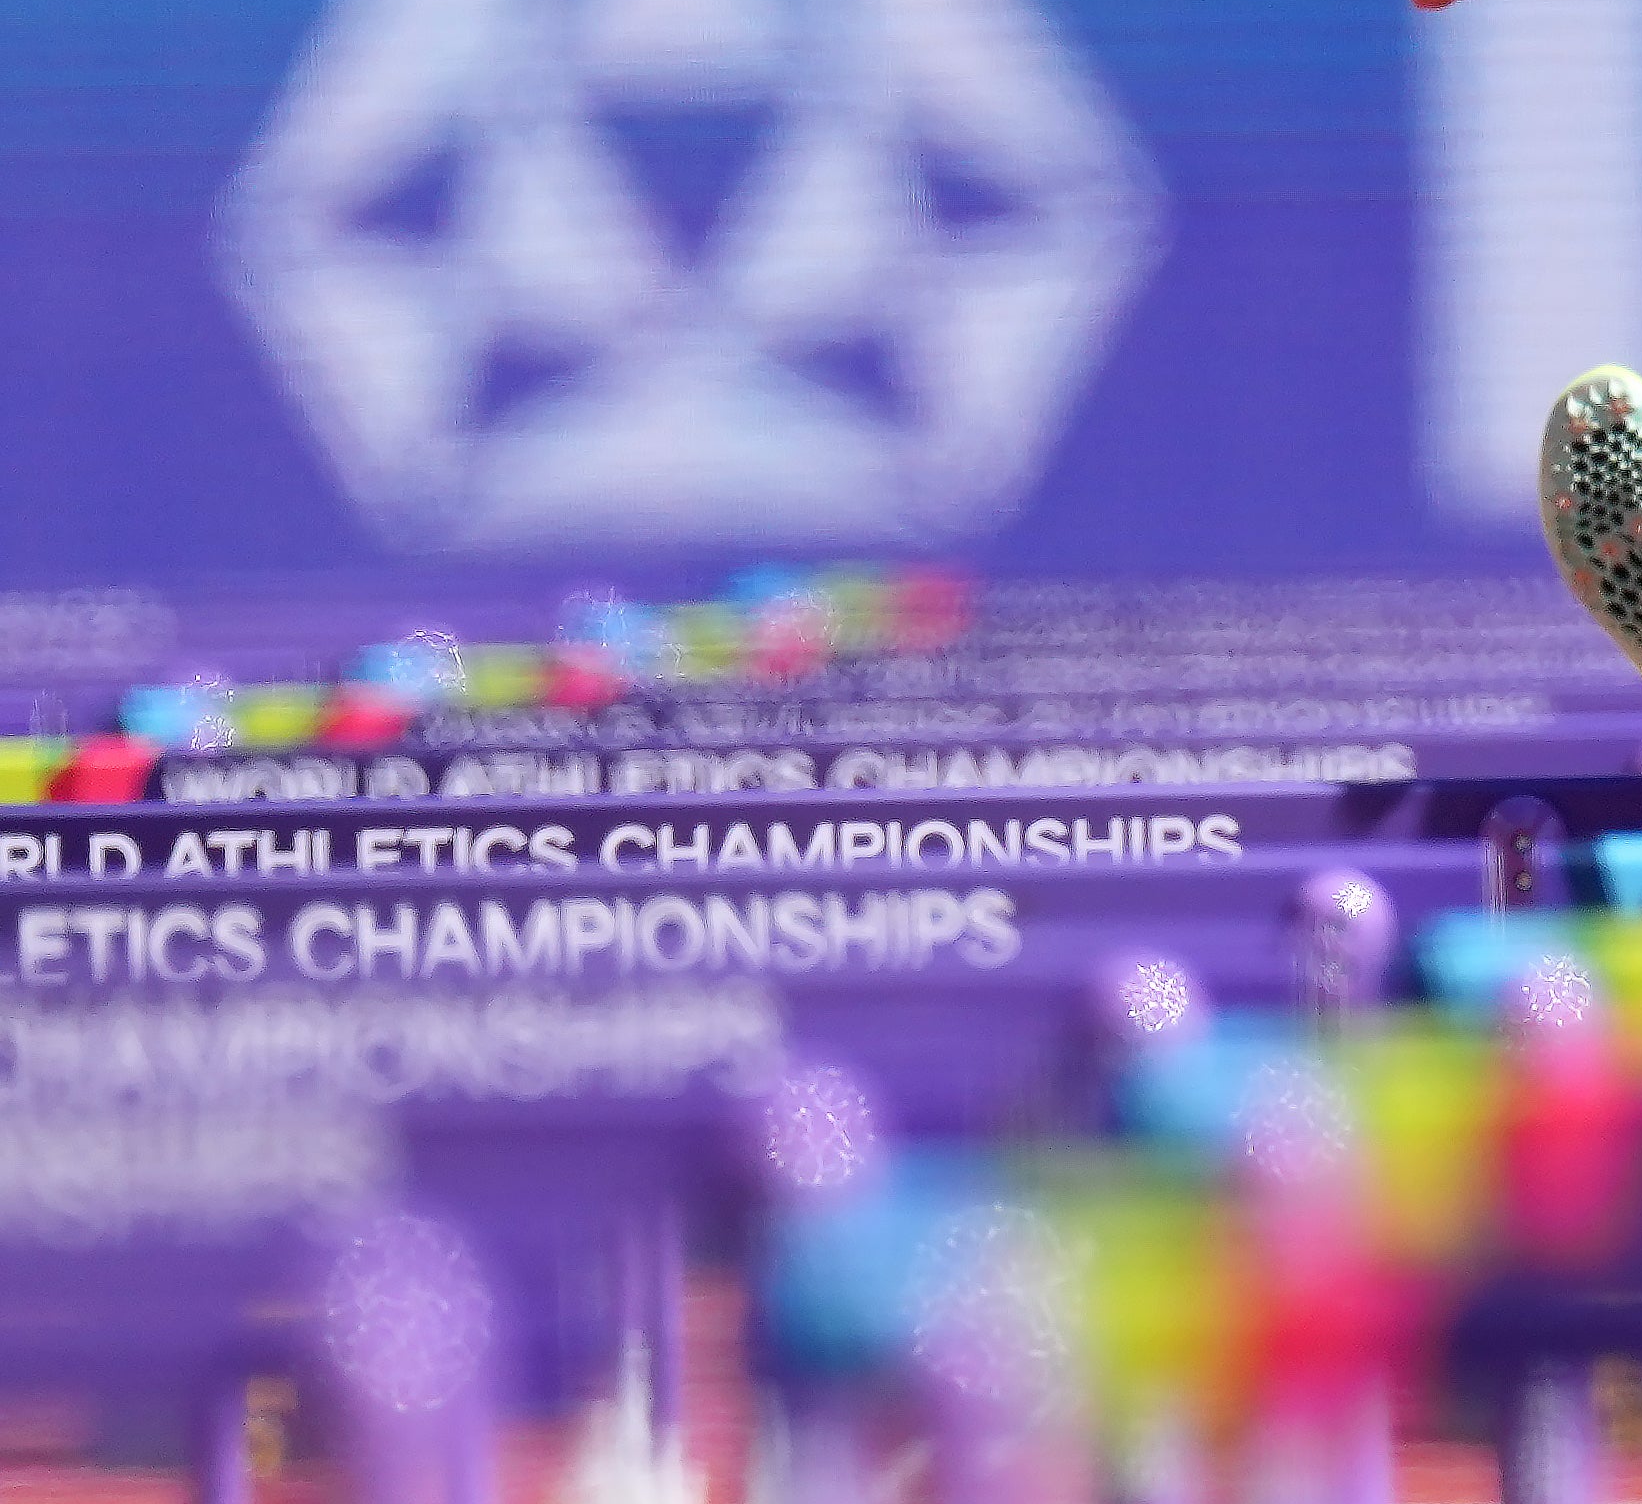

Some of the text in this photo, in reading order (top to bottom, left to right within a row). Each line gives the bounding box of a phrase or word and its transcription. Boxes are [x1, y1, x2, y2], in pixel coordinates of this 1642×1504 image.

[163, 823, 580, 880] ATHLETICS
[598, 811, 1244, 873] CHAMPIONSHIPS
[0, 887, 1022, 987] ETICS CHAMPIONSHIPS
